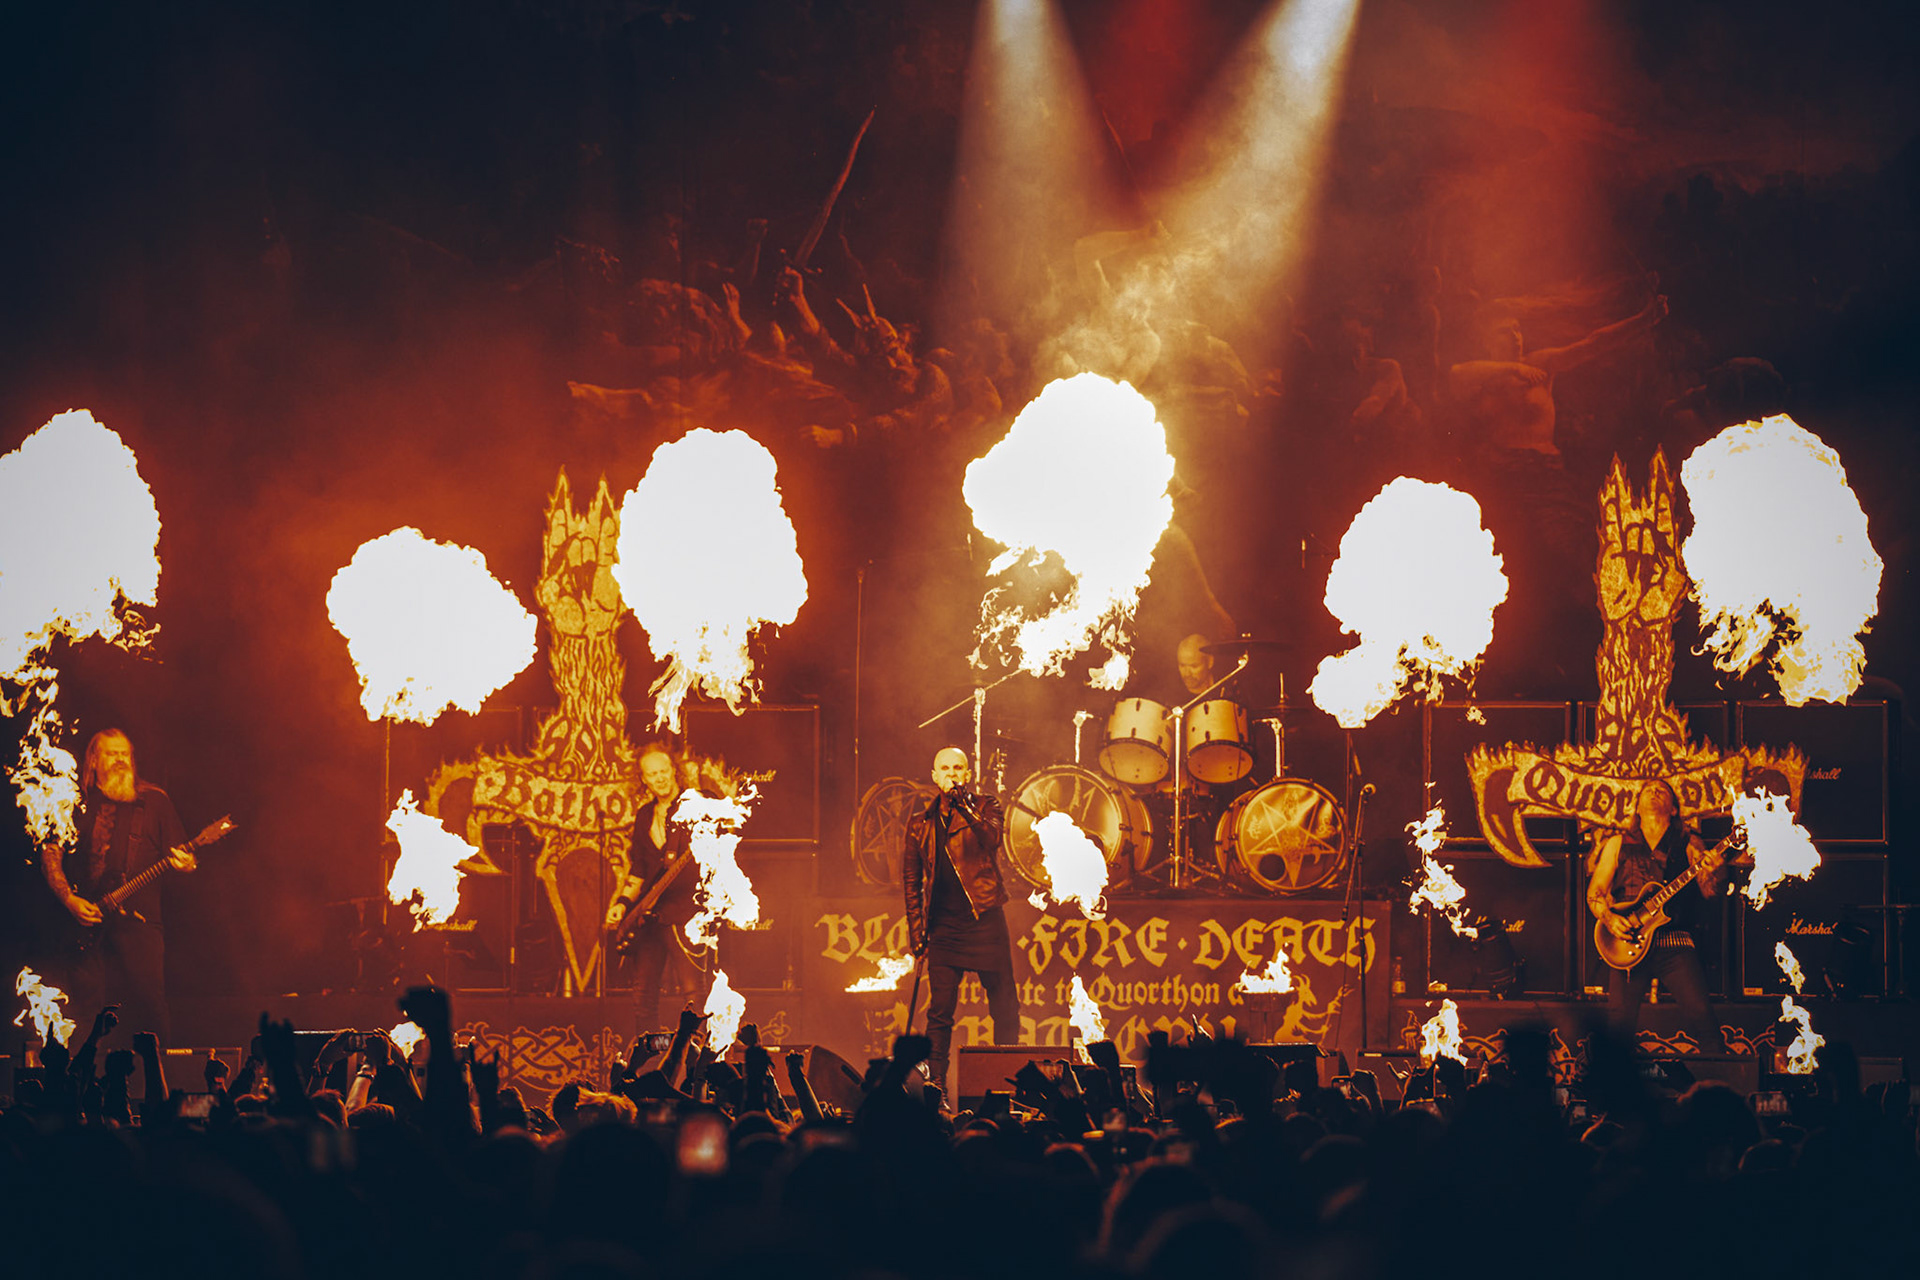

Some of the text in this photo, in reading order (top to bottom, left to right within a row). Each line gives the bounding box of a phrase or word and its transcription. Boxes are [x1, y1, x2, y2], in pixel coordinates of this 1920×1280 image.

[489, 758, 638, 829] Batho
[1524, 760, 1727, 824] Quoron
[814, 912, 1376, 975] BLO FIRE DEATH
[1785, 918, 1839, 935] Marsha
[1087, 971, 1220, 1013] Quorthon
